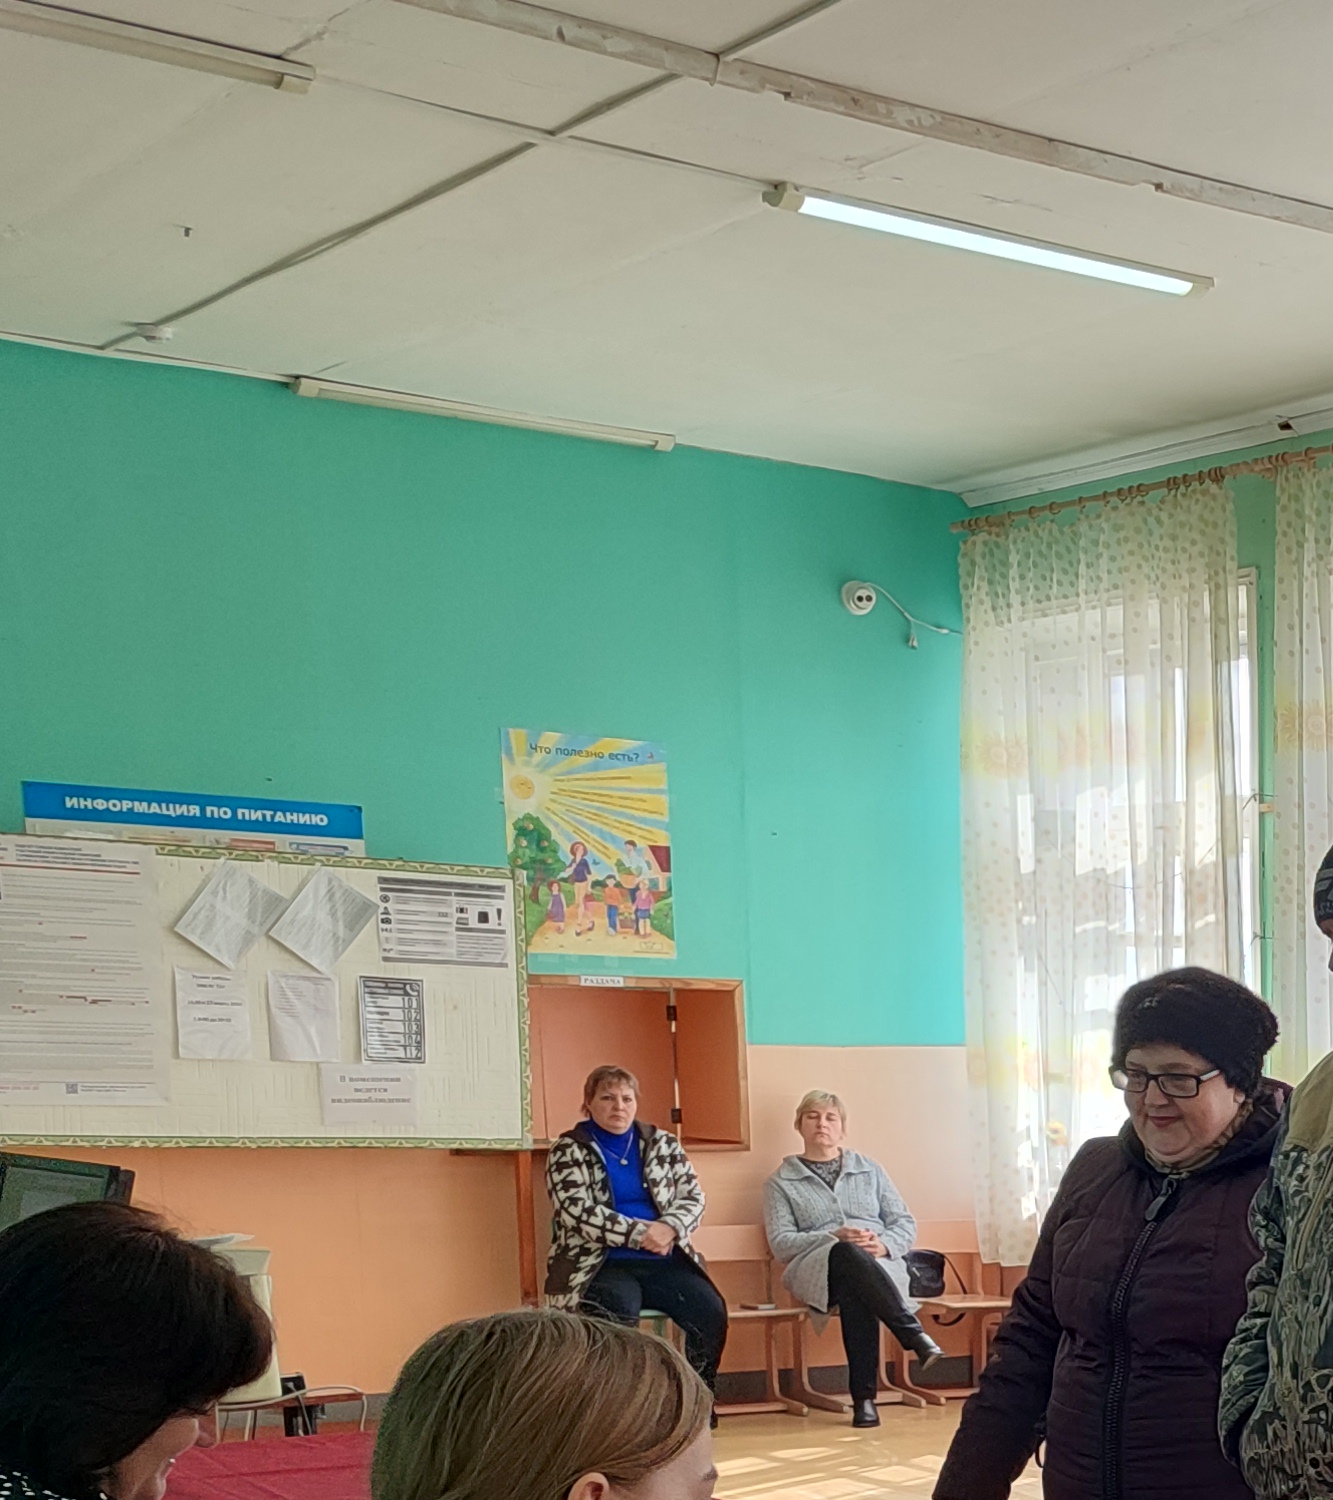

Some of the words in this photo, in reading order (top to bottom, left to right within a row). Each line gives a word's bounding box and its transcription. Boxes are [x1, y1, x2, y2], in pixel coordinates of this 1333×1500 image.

[529, 743, 552, 755] Что
[555, 747, 605, 760] полезно
[608, 752, 640, 763] есть?
[64, 796, 201, 818] ИНФОРМАЦИЯ
[205, 806, 232, 820] ПО
[236, 808, 329, 826] ПИТАНИЮ
[401, 997, 420, 1009] 101
[402, 1009, 420, 1021] 102
[402, 1022, 421, 1033] 103
[403, 1034, 421, 1046] 104
[403, 1047, 421, 1058] 112
